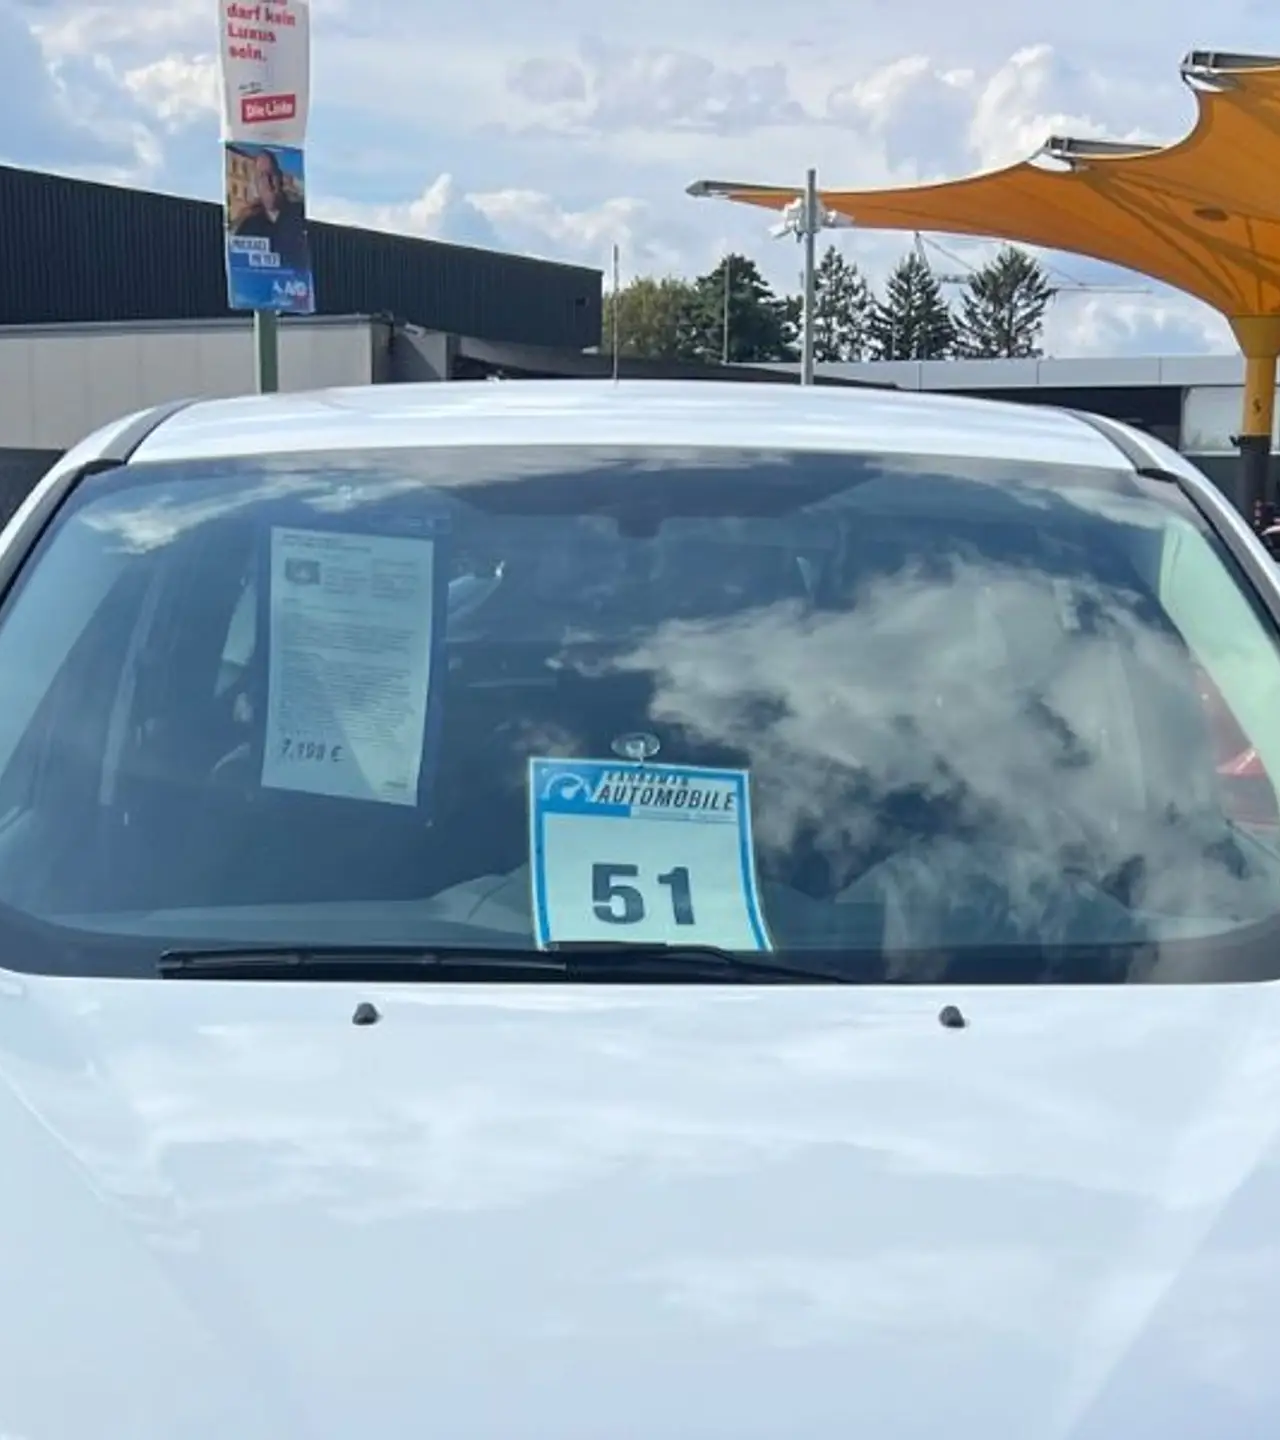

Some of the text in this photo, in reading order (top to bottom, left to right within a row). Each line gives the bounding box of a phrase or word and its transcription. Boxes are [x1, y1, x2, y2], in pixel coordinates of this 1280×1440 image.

[226, 3, 296, 27] darf kein
[227, 22, 277, 43] Luxus
[228, 43, 268, 62] sein.
[598, 783, 737, 812] AUTOMOBILE
[591, 862, 697, 926] 51
